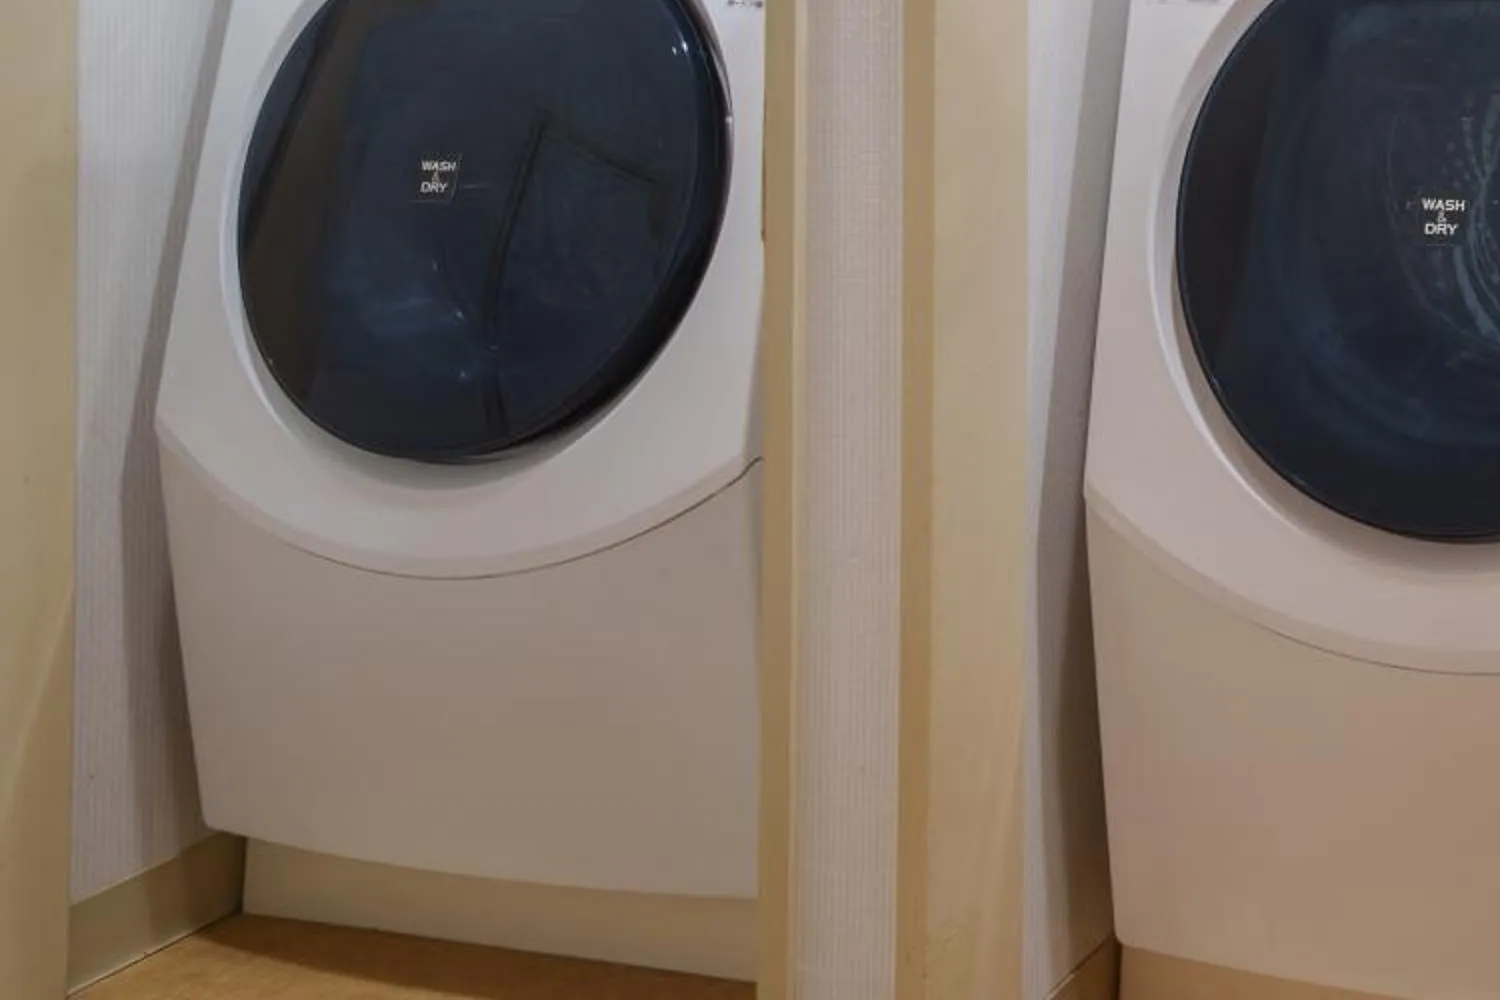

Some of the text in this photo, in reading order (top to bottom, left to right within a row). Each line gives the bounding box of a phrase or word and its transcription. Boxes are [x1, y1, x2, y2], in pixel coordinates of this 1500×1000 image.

[422, 160, 457, 172] WASH
[420, 182, 448, 193] DRY
[1421, 198, 1466, 211] WASH
[1424, 223, 1459, 236] DRY
